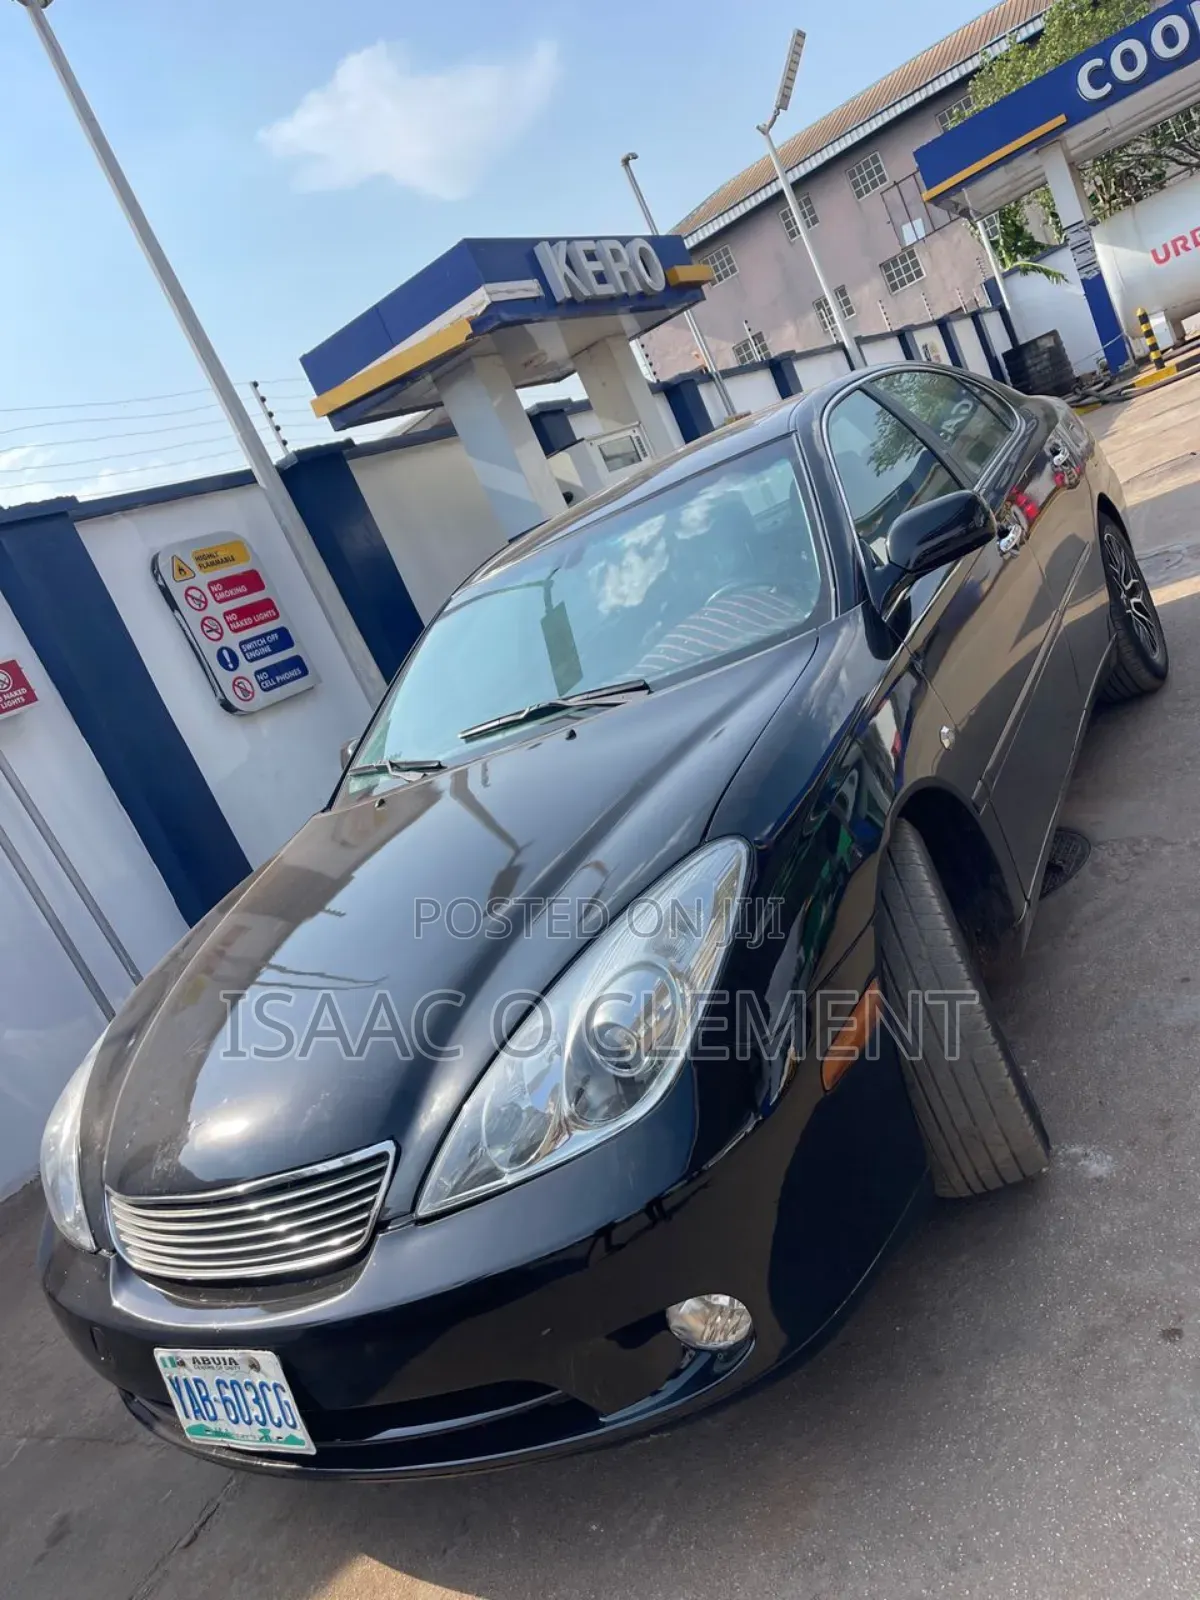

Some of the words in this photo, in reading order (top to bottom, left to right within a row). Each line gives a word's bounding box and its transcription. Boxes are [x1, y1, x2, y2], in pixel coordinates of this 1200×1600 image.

[1076, 0, 1200, 102] COO
[534, 237, 667, 303] KERO
[195, 551, 218, 561] HIGHLY
[198, 555, 236, 569] FLAMMABLE
[210, 583, 223, 593] NO
[215, 585, 248, 600] SMOKING
[225, 613, 238, 622] NO
[230, 617, 253, 630] NAKED
[253, 609, 276, 622] LIGHTS
[241, 637, 267, 652] SWITCH
[266, 633, 279, 644] OFF
[245, 645, 272, 660] ENGINE
[257, 672, 269, 682] NO
[260, 679, 276, 689] CELL
[275, 667, 302, 683] PHONES
[191, 1356, 239, 1366] ABUJA
[168, 1375, 298, 1430] YAB-603CG
